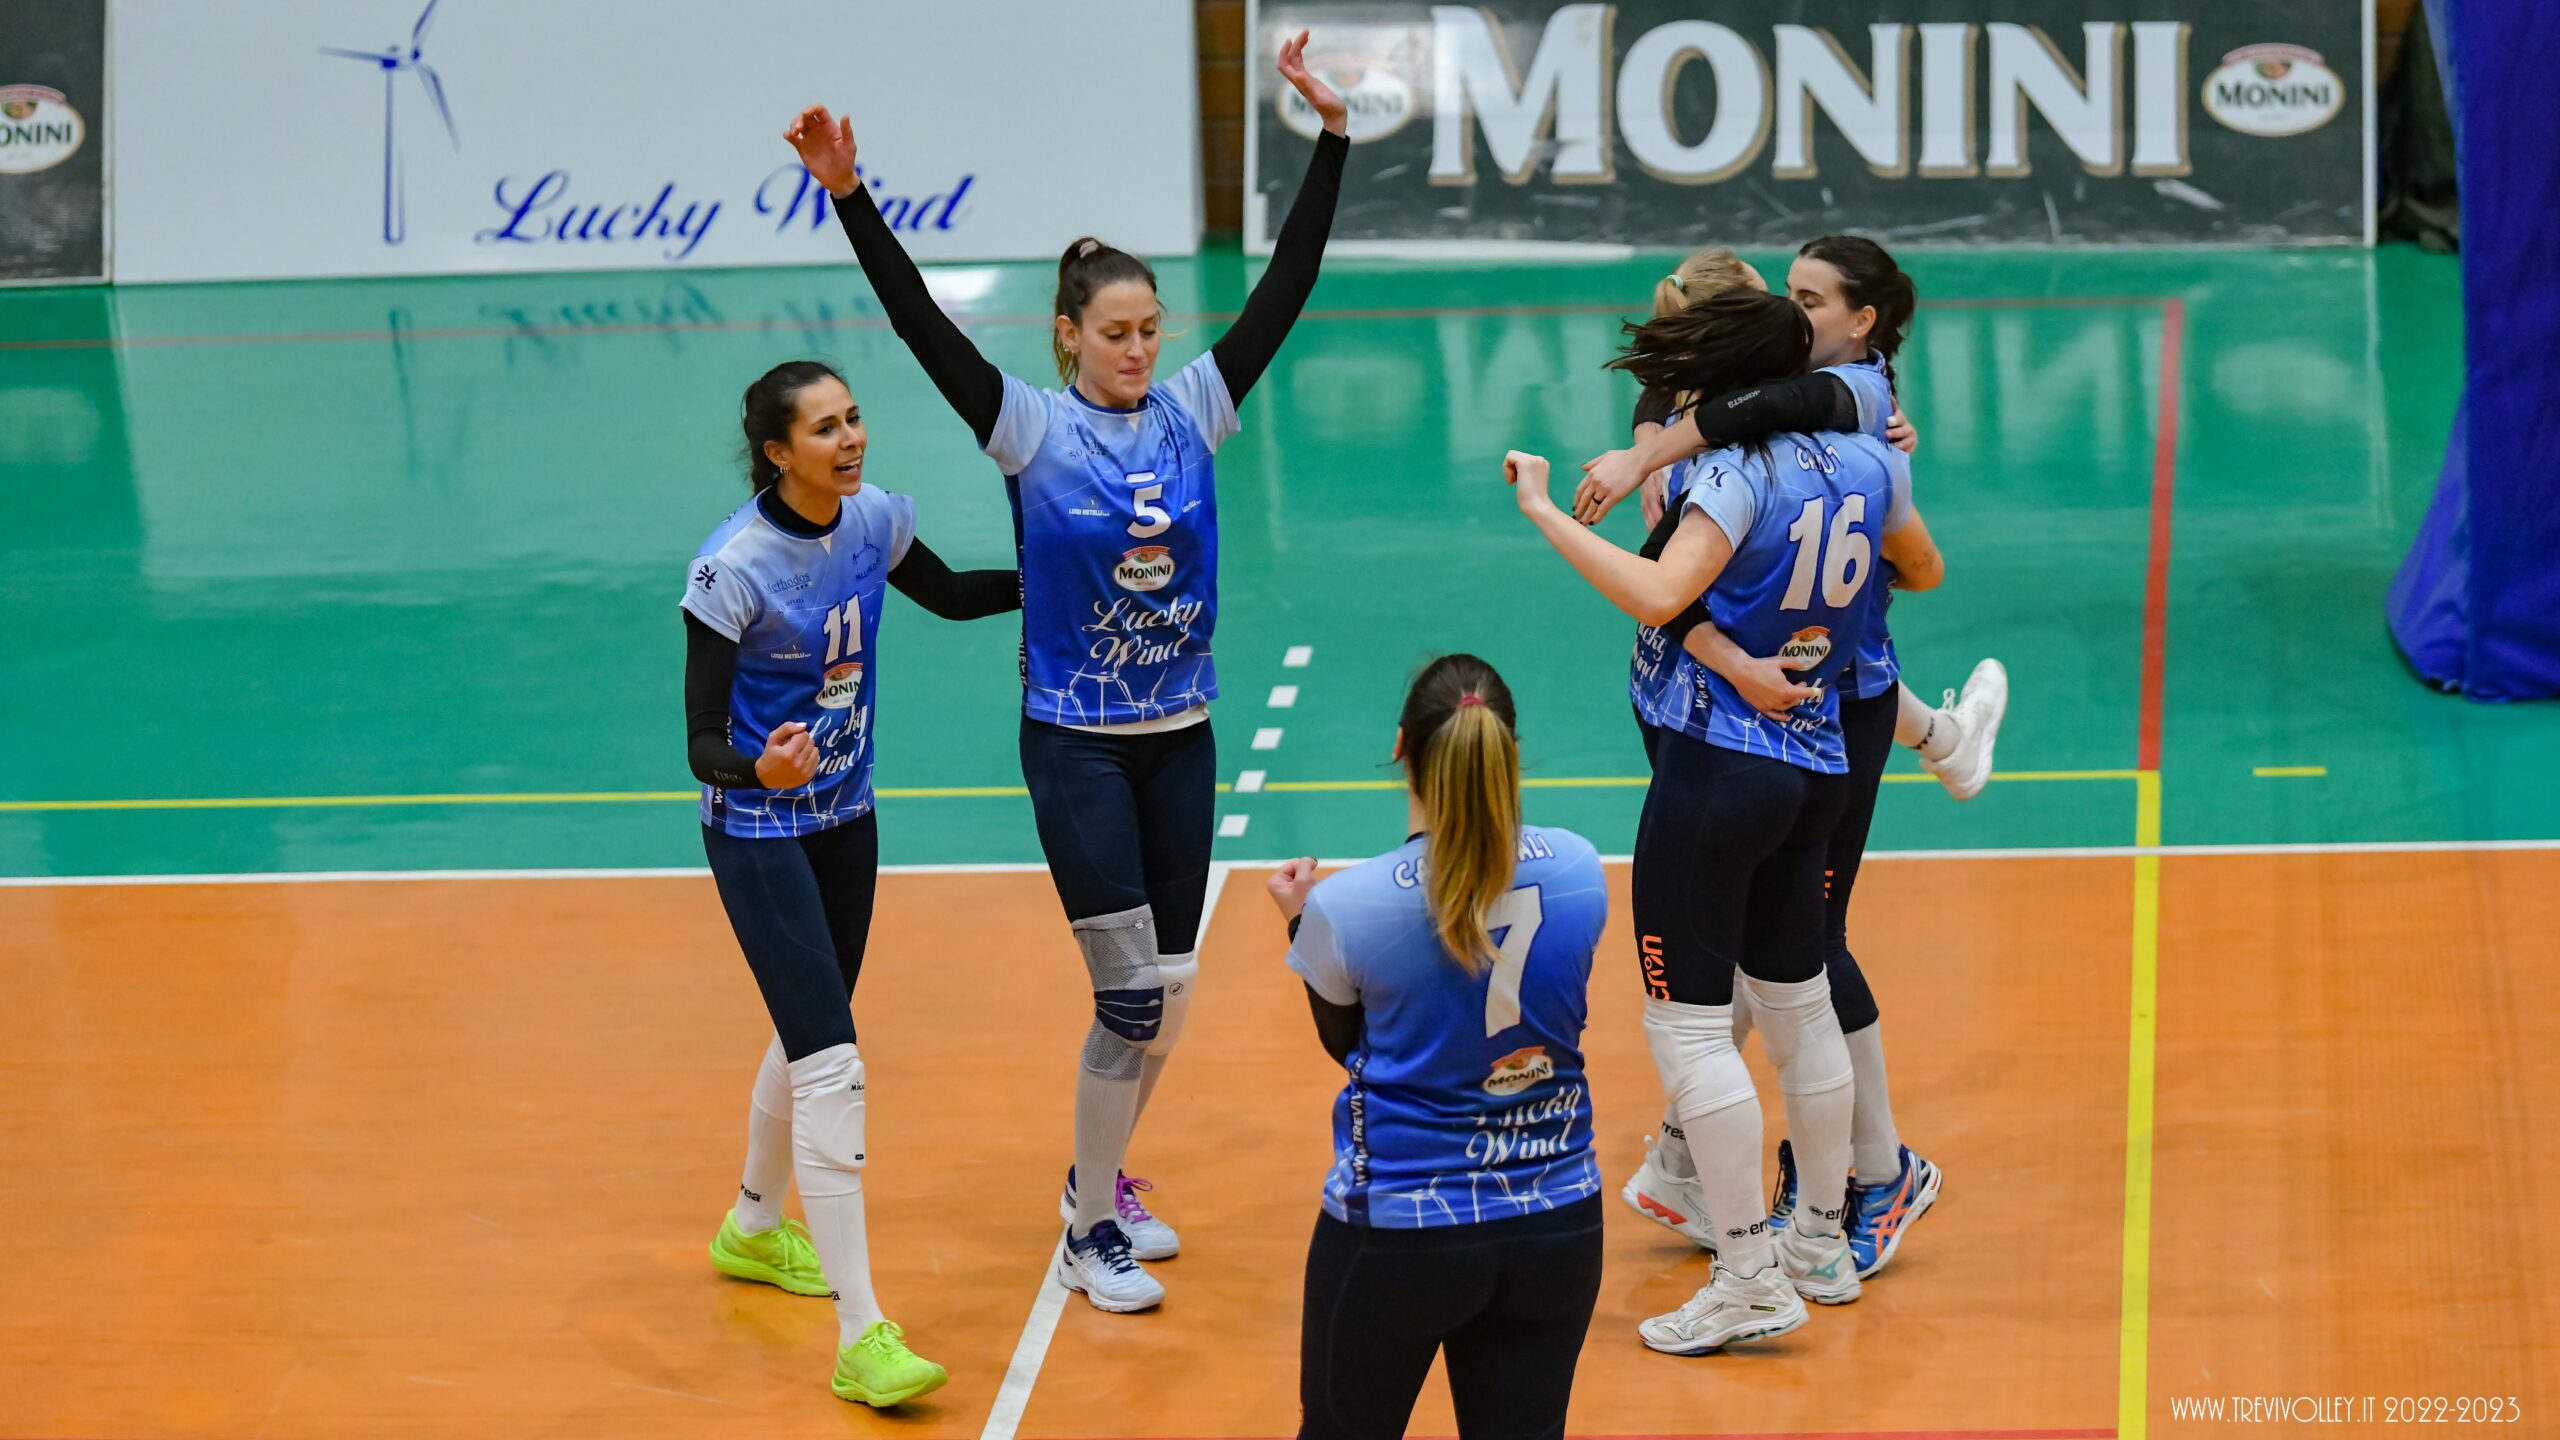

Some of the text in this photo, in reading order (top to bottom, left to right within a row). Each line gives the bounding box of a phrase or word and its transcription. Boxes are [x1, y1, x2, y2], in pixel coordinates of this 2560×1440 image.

[1290, 92, 1403, 114] MNINI
[1427, 3, 2192, 186] MONINI
[2216, 82, 2330, 107] MONINI
[0, 124, 71, 146] ONINI
[473, 163, 975, 261] Lucky Wnd
[1127, 483, 1171, 539] 5
[1779, 492, 1871, 610] 16
[1119, 564, 1171, 579] MONINI
[823, 592, 862, 665] 11
[1081, 596, 1202, 632] Lucky
[1090, 631, 1190, 667] Wind
[1782, 645, 1828, 657] MONINI
[818, 680, 861, 700] MONIN
[1485, 883, 1543, 1039] 7
[1487, 1062, 1549, 1087] MONINI
[1465, 1121, 1569, 1166] Wind
